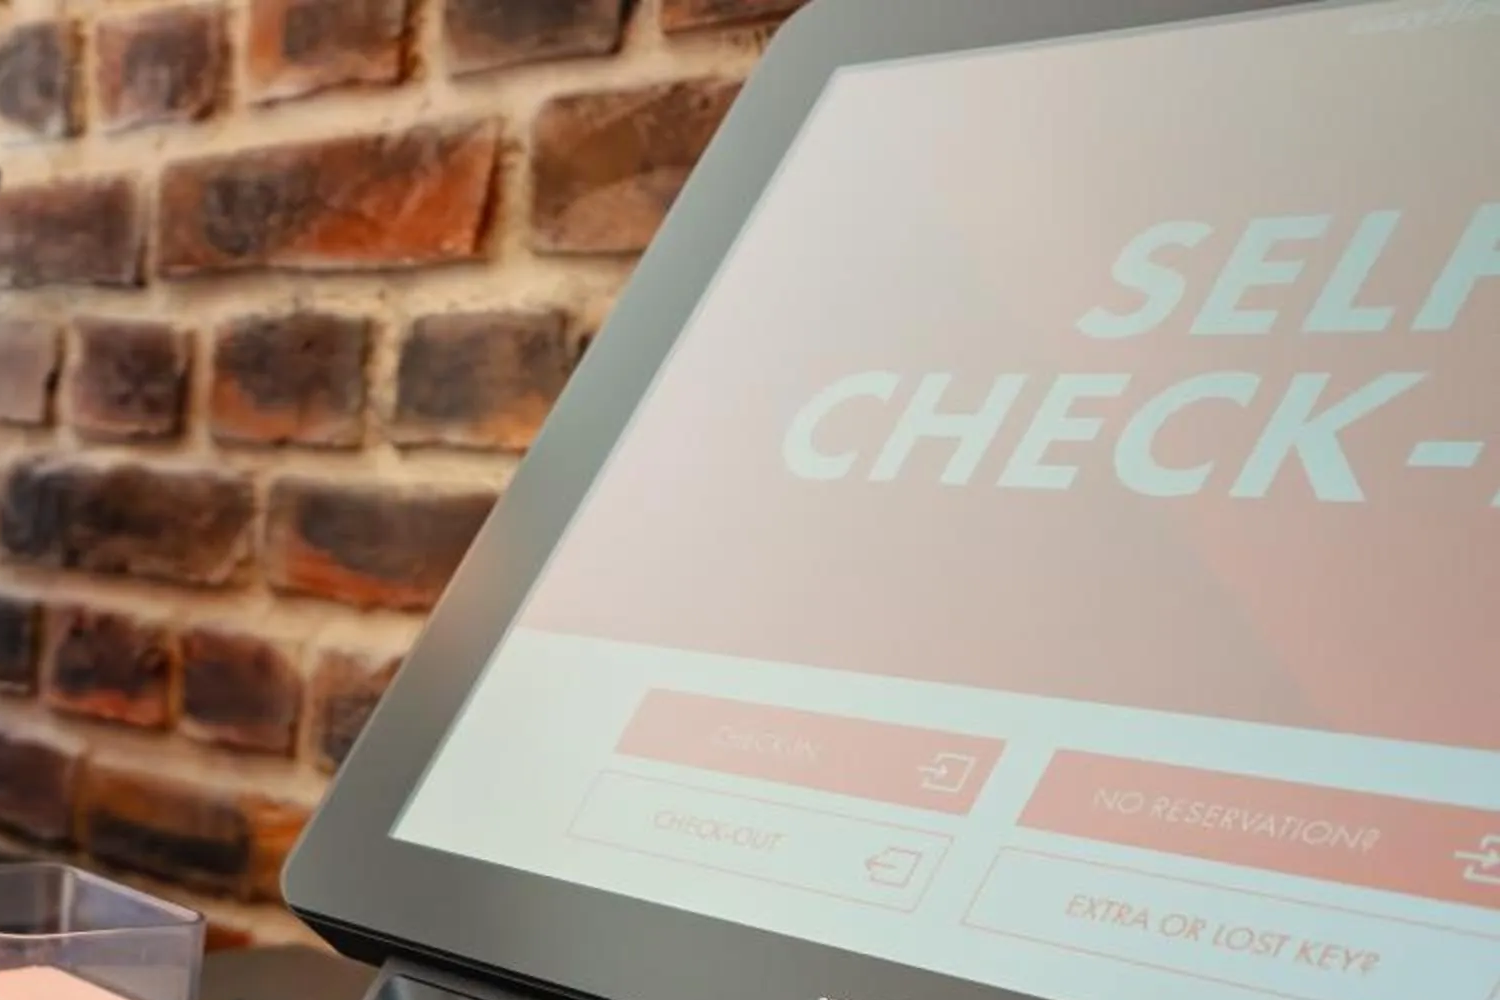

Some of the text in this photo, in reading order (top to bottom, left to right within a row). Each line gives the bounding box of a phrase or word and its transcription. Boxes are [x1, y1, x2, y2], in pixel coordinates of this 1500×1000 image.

[1074, 203, 1500, 340] SELF
[781, 370, 1500, 506] CHECK-
[653, 810, 785, 850] CHECK-OUT
[1092, 789, 1381, 851] NO RESERVATION?
[1065, 894, 1381, 975] EXTRA OR LOST KEY?
